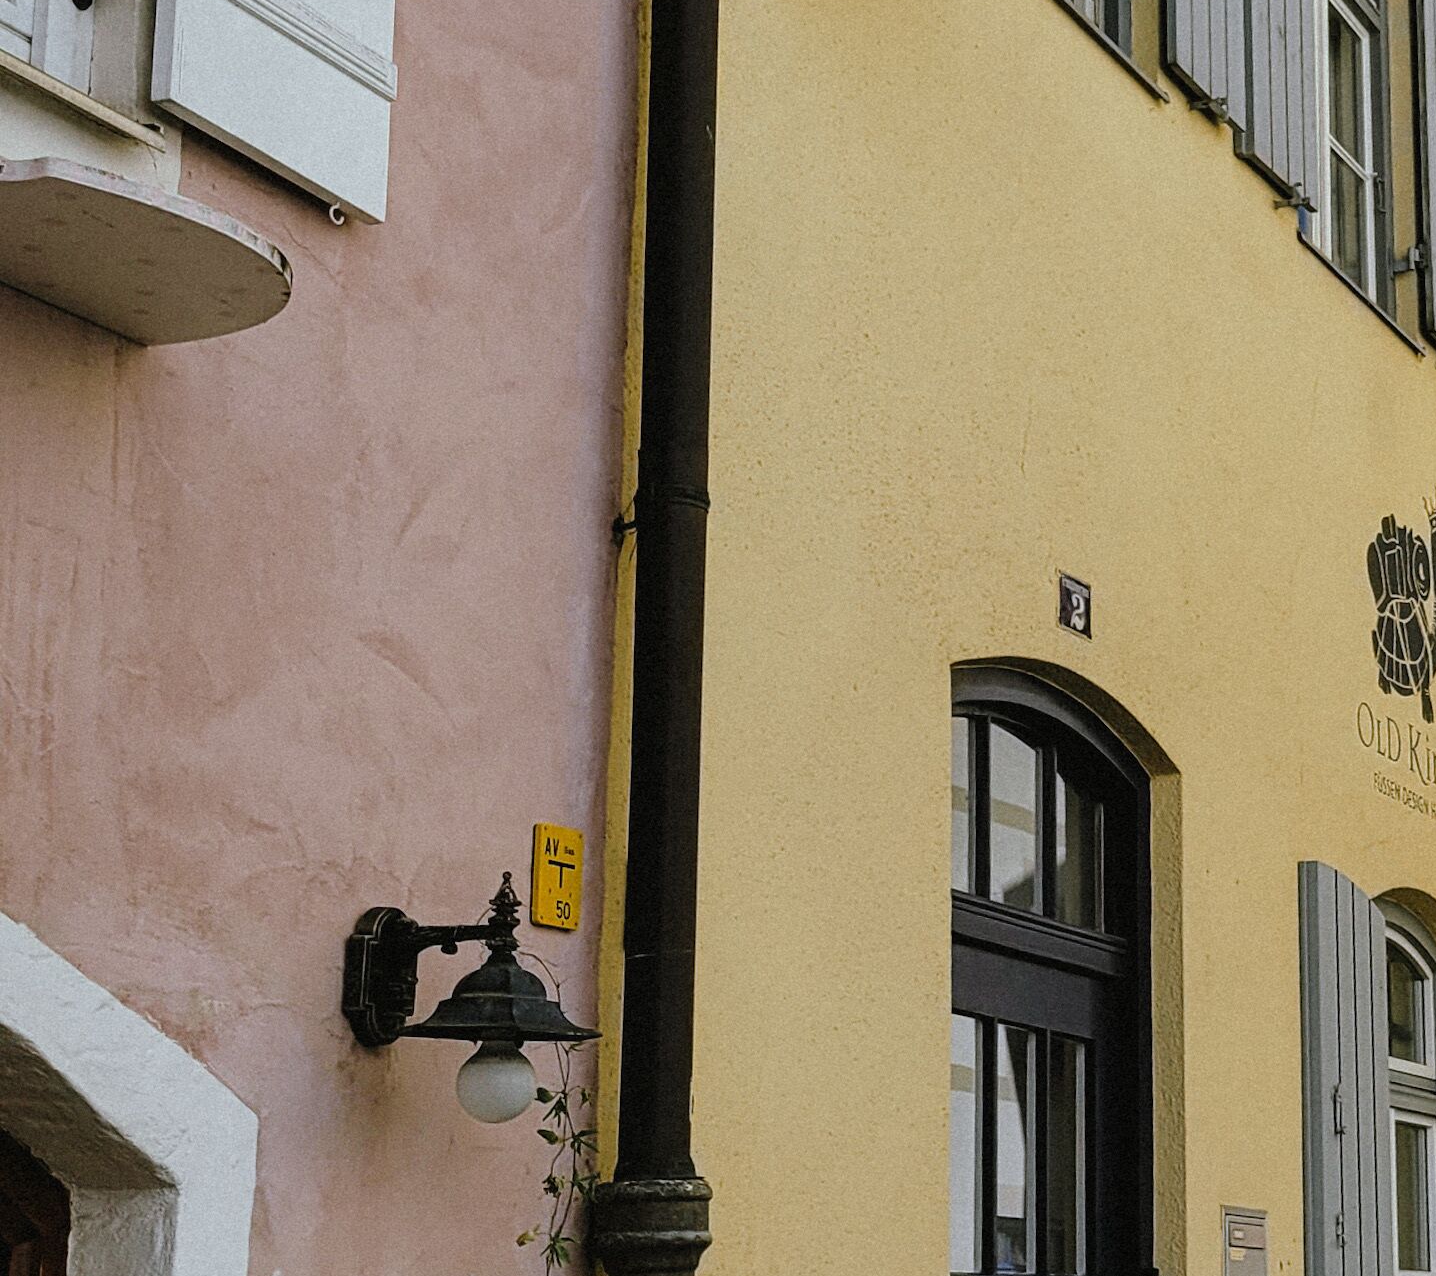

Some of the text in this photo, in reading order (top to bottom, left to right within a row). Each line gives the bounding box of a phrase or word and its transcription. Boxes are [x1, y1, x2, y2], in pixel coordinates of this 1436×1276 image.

[1070, 593, 1085, 631] 2
[1358, 702, 1401, 762] OLD
[545, 837, 560, 857] AV
[556, 900, 571, 920] 50
